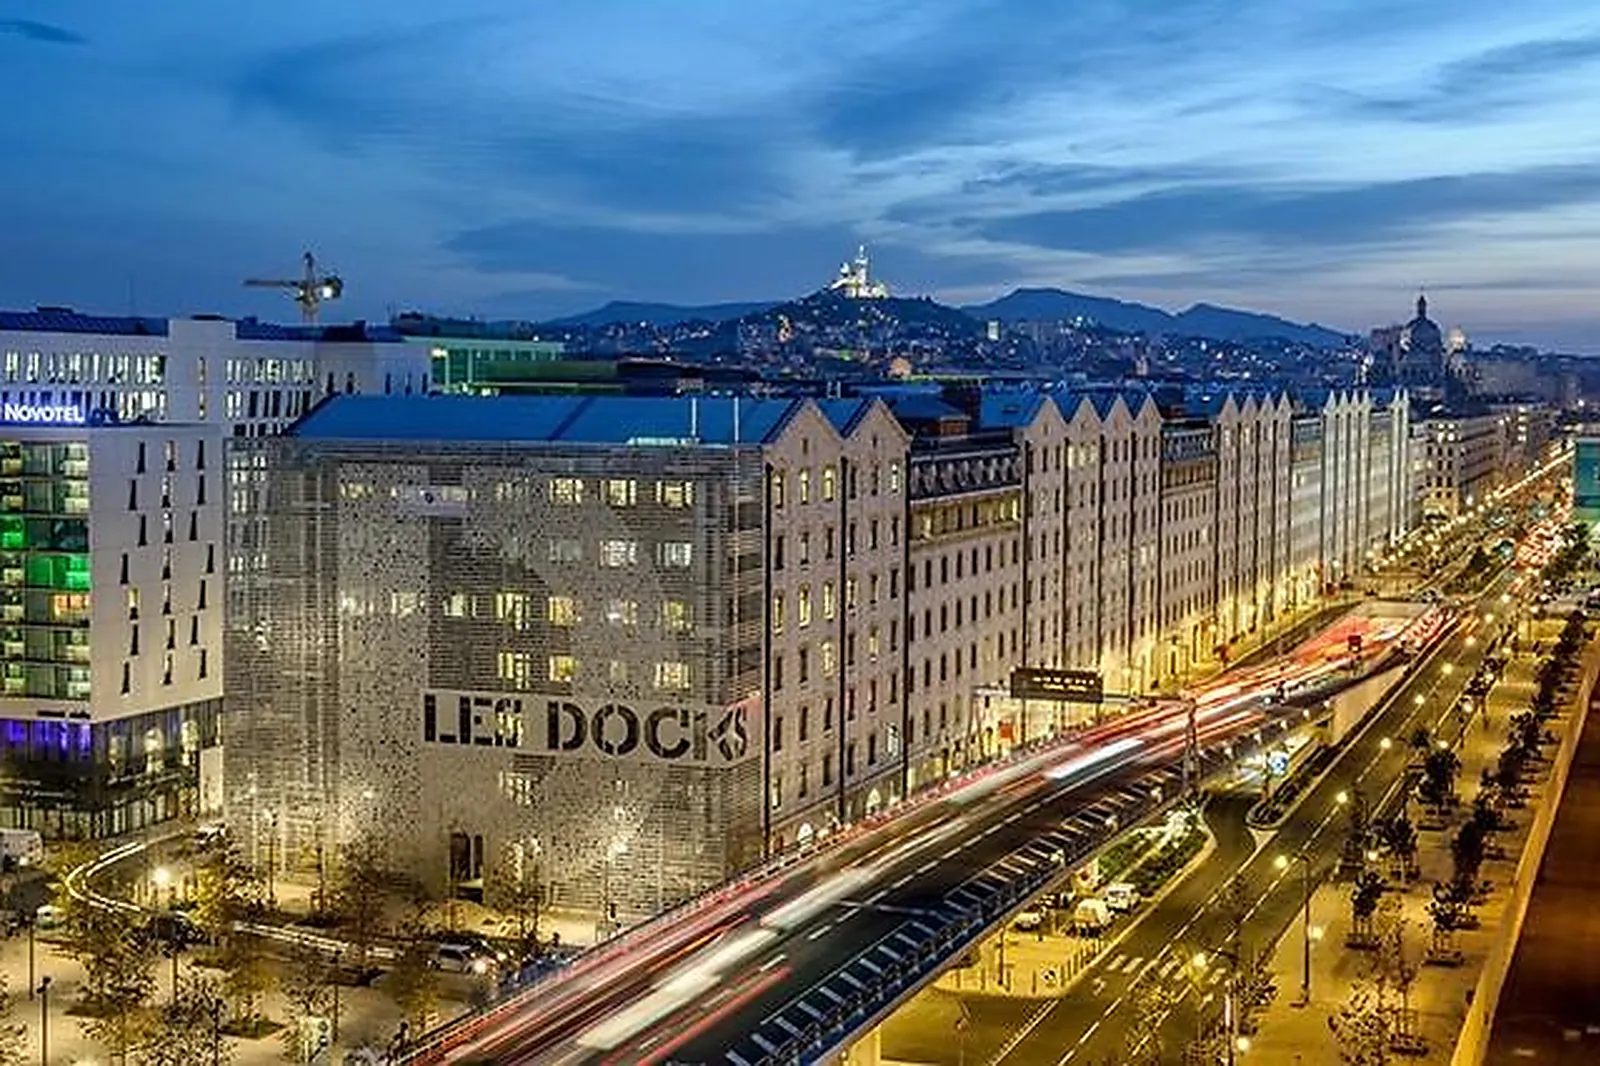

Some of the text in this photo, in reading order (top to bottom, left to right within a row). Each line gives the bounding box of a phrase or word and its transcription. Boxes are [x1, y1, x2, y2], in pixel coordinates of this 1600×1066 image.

[4, 403, 85, 423] NOVOTEL
[424, 694, 748, 761] LES DOCKS
